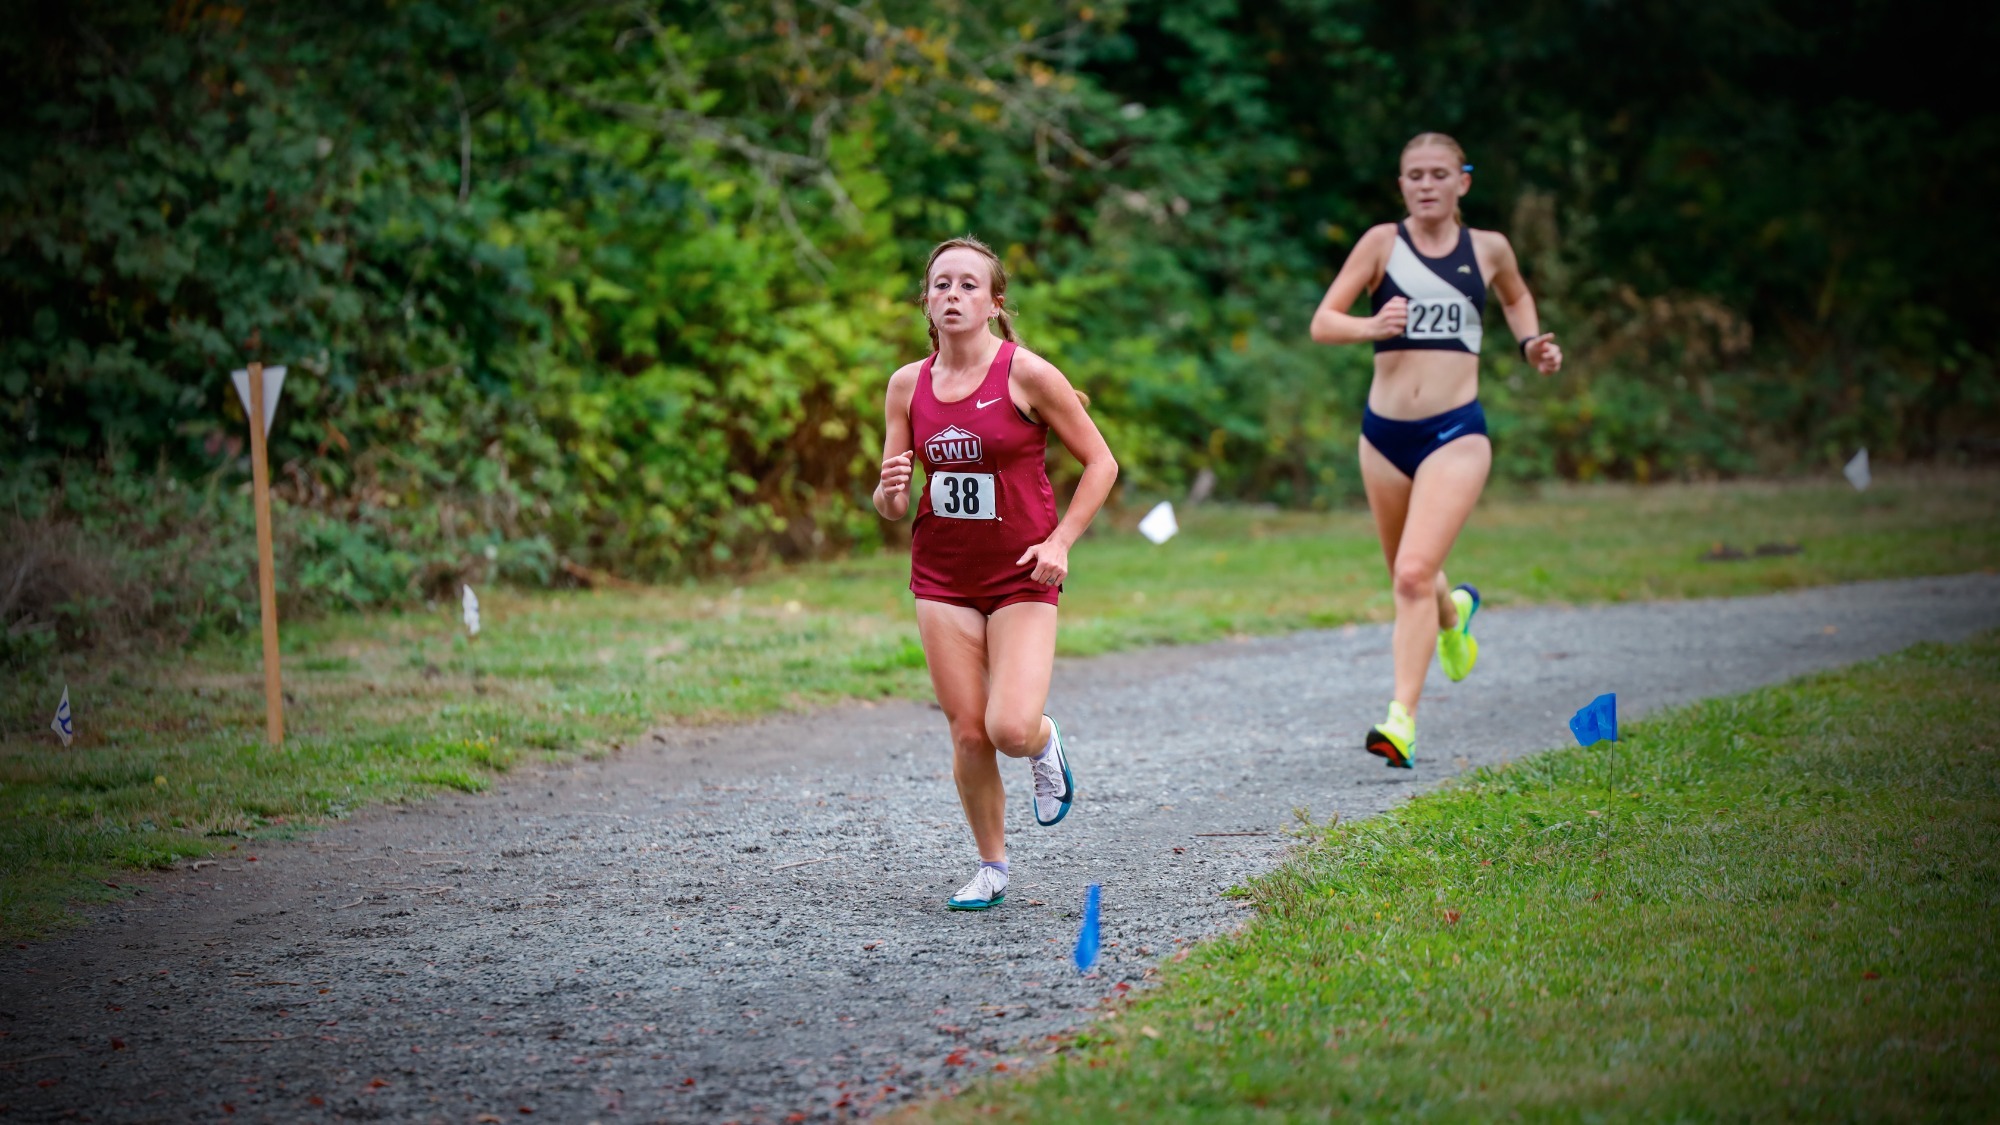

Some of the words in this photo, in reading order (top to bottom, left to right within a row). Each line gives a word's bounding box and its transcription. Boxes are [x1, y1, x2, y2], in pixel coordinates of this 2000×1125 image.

[1411, 303, 1461, 333] 229
[928, 440, 978, 462] CWU
[943, 476, 980, 515] 38
